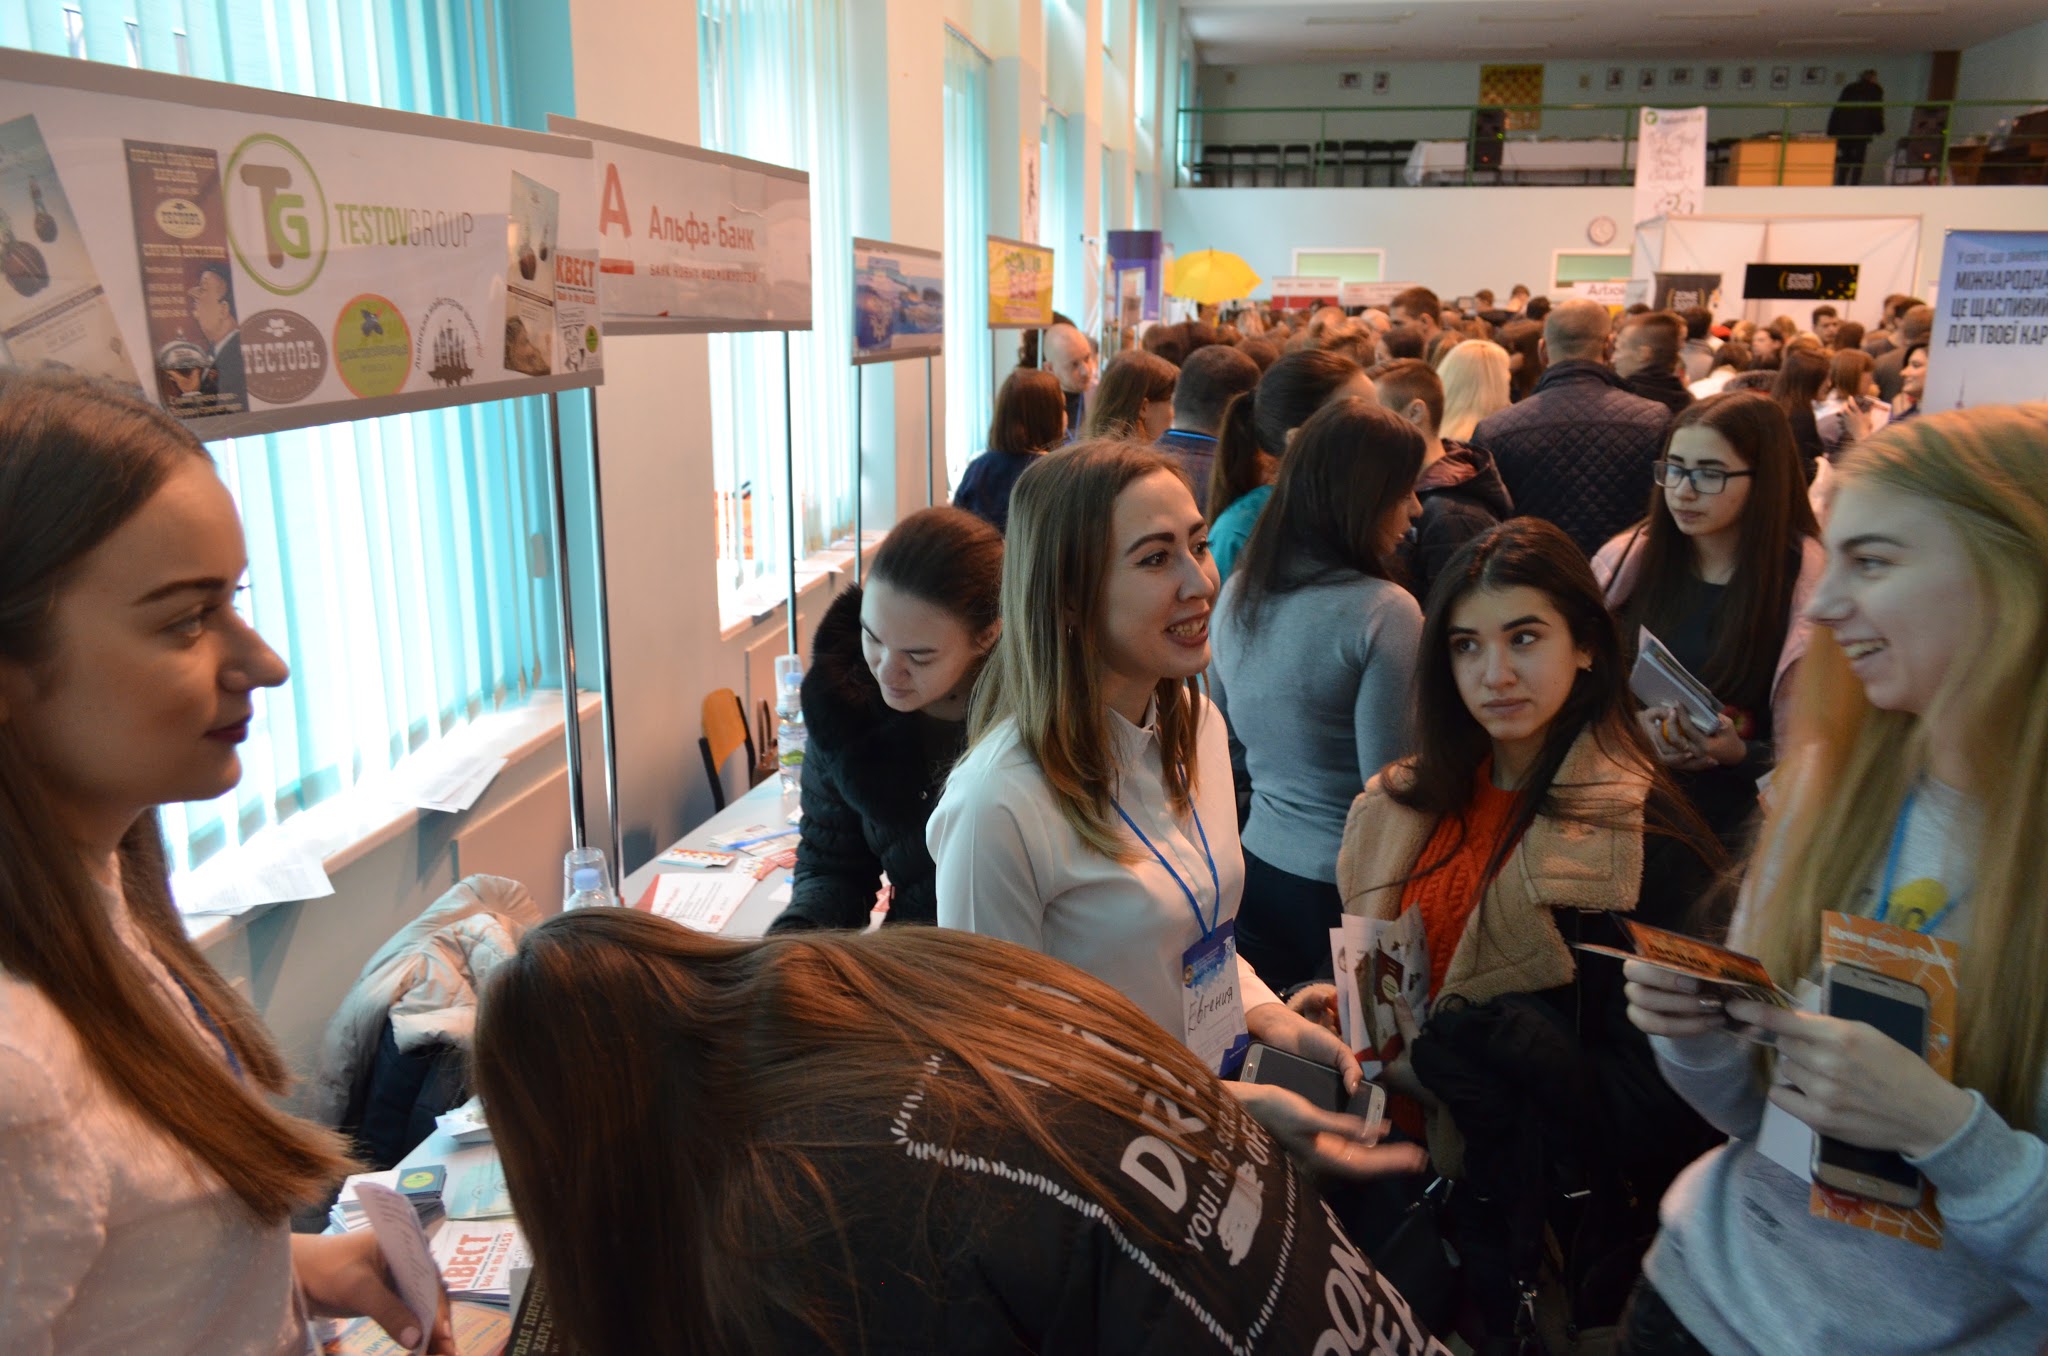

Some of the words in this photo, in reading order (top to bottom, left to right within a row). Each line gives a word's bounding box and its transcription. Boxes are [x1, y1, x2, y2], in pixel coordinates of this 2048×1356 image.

[334, 203, 474, 248] TESTOVGROUP
[555, 254, 596, 288] КВЕСТ
[1946, 324, 1978, 348] ДЛЯ
[241, 340, 321, 374] ТЕСТОВЪ
